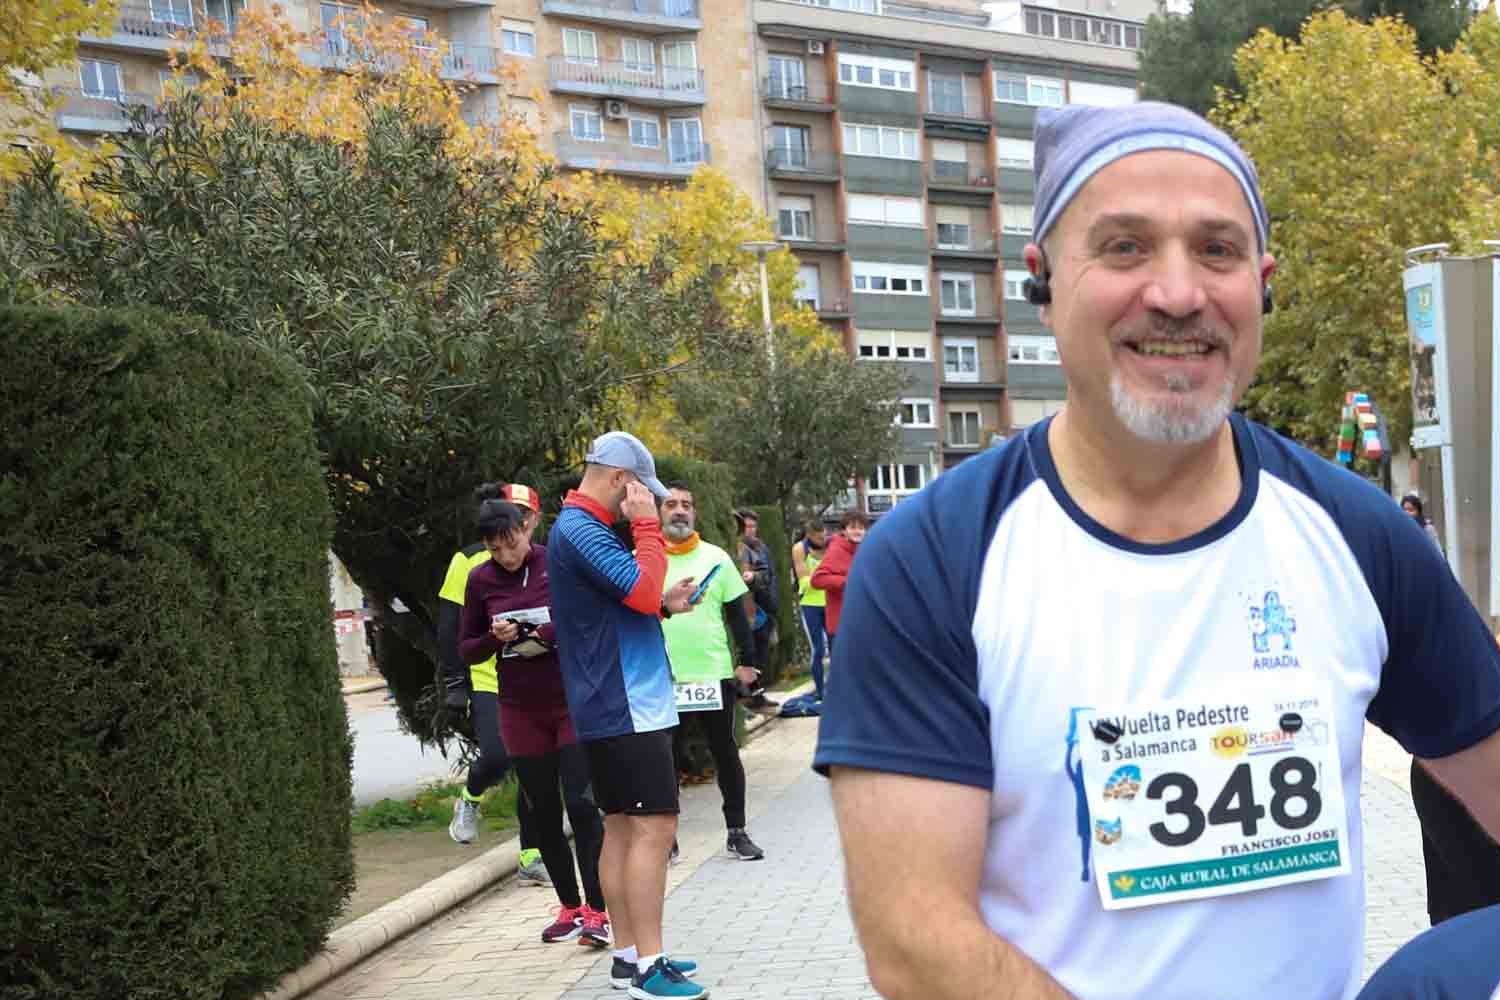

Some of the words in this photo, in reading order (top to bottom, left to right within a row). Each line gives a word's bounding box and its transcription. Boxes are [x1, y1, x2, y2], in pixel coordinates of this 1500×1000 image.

[685, 687, 717, 701] 162
[1115, 711, 1172, 738] Vuelta
[1176, 704, 1250, 728] Pedestre
[1101, 749, 1111, 763] a
[1114, 738, 1198, 761] Salamanca
[1146, 756, 1323, 848] 348
[1220, 835, 1301, 857] FRANCISCO
[1140, 875, 1177, 891] CAJA
[1180, 868, 1229, 885] RURAL
[1232, 864, 1251, 879] DE
[1252, 849, 1340, 876] SALAMANCA
